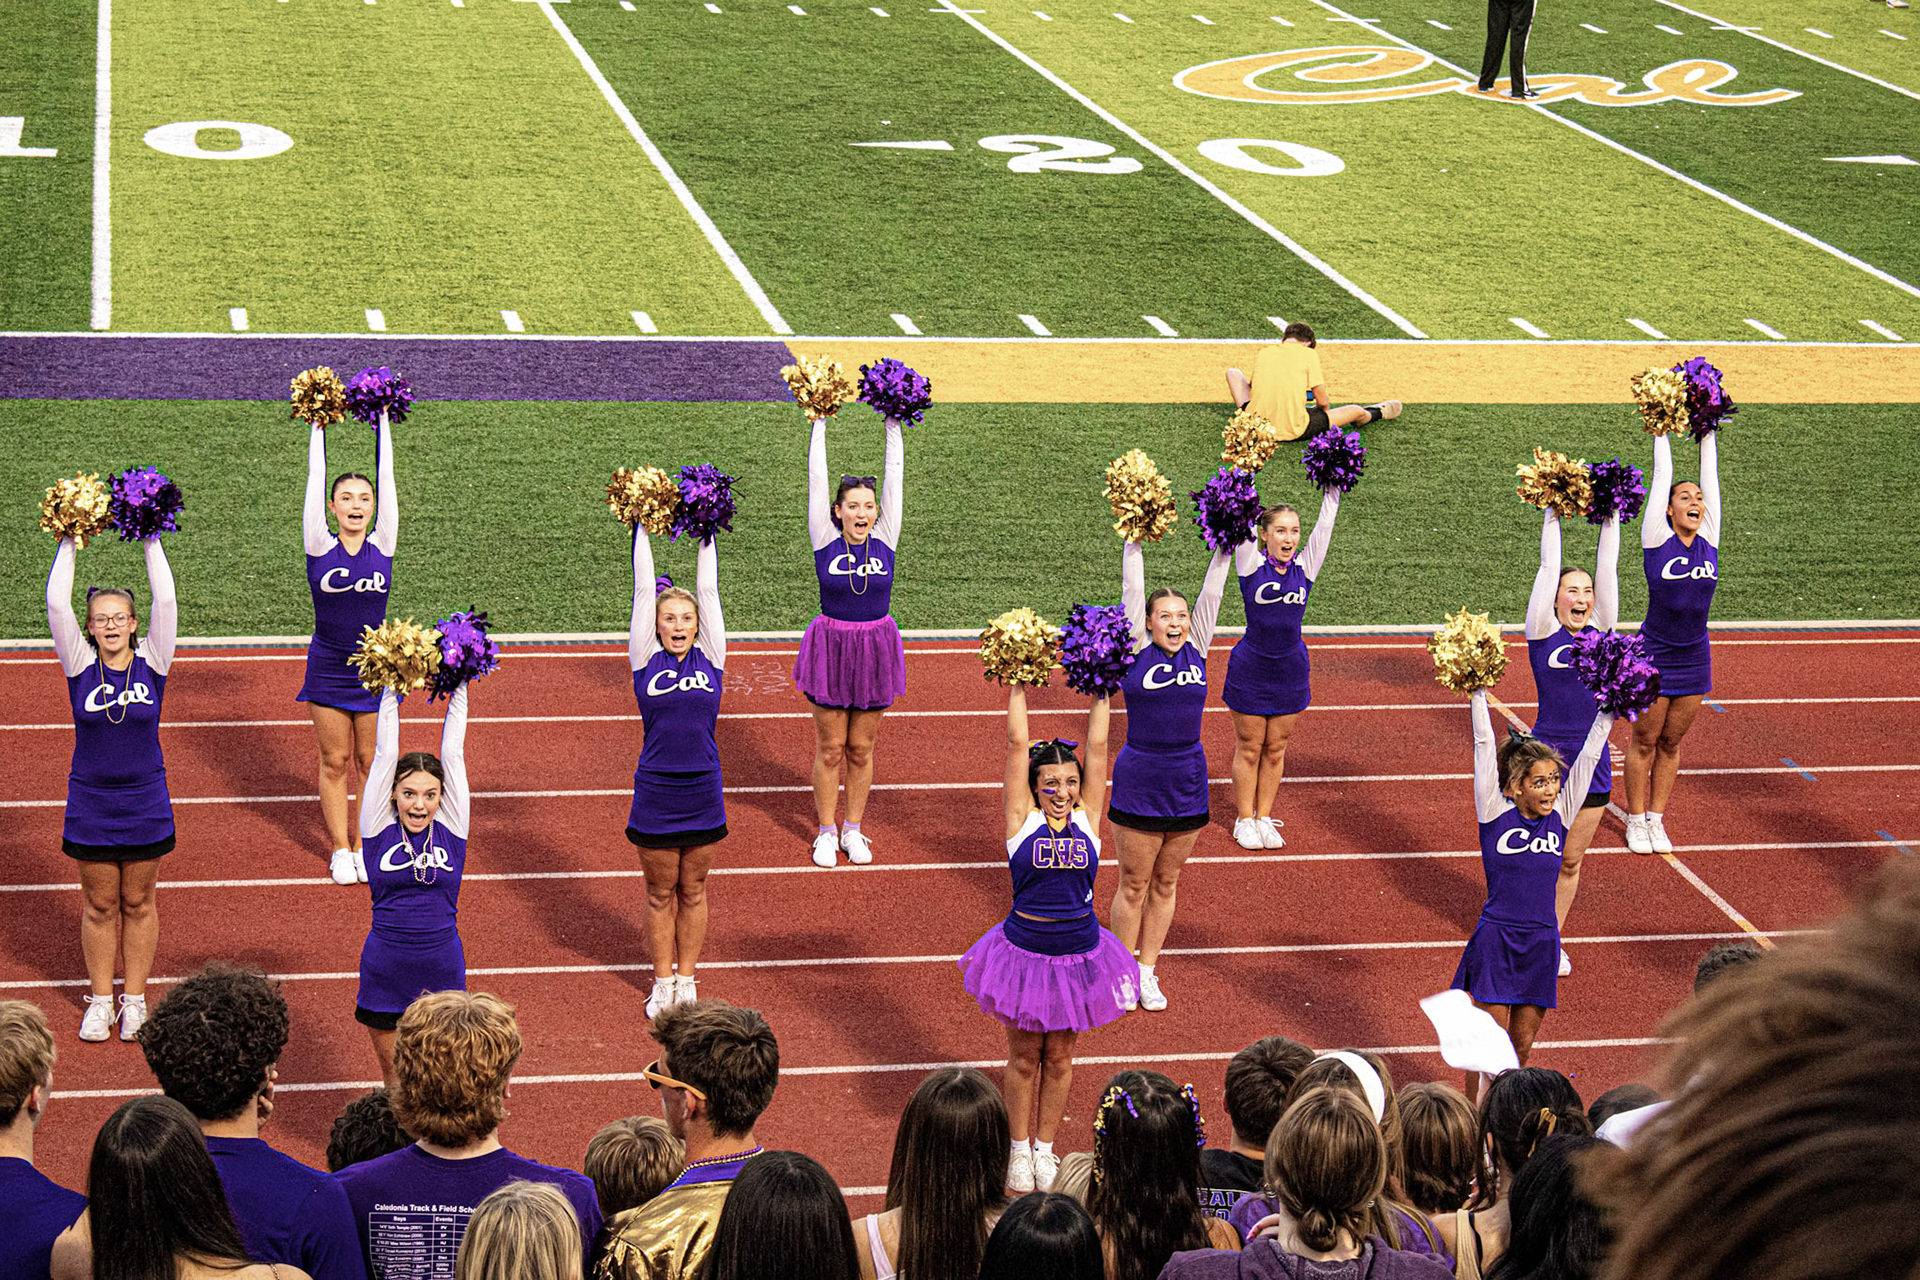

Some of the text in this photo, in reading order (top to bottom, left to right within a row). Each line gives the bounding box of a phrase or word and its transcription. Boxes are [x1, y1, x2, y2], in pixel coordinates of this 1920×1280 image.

[1172, 46, 1804, 107] Cal
[977, 135, 1345, 176] 20
[828, 553, 888, 577] Cal
[1660, 556, 1719, 581] Cal
[320, 567, 388, 594] Cal
[1254, 581, 1307, 606] Cal
[646, 669, 714, 697] Cal
[1142, 663, 1207, 690] Cal
[84, 681, 154, 713] Cal
[1033, 838, 1089, 869] CHS
[1495, 827, 1562, 856] Cal
[379, 841, 453, 872] Cal
[374, 1203, 409, 1212] Caledonia
[410, 1204, 430, 1212] Track
[439, 1205, 457, 1213] Field
[458, 1206, 477, 1214] Scho
